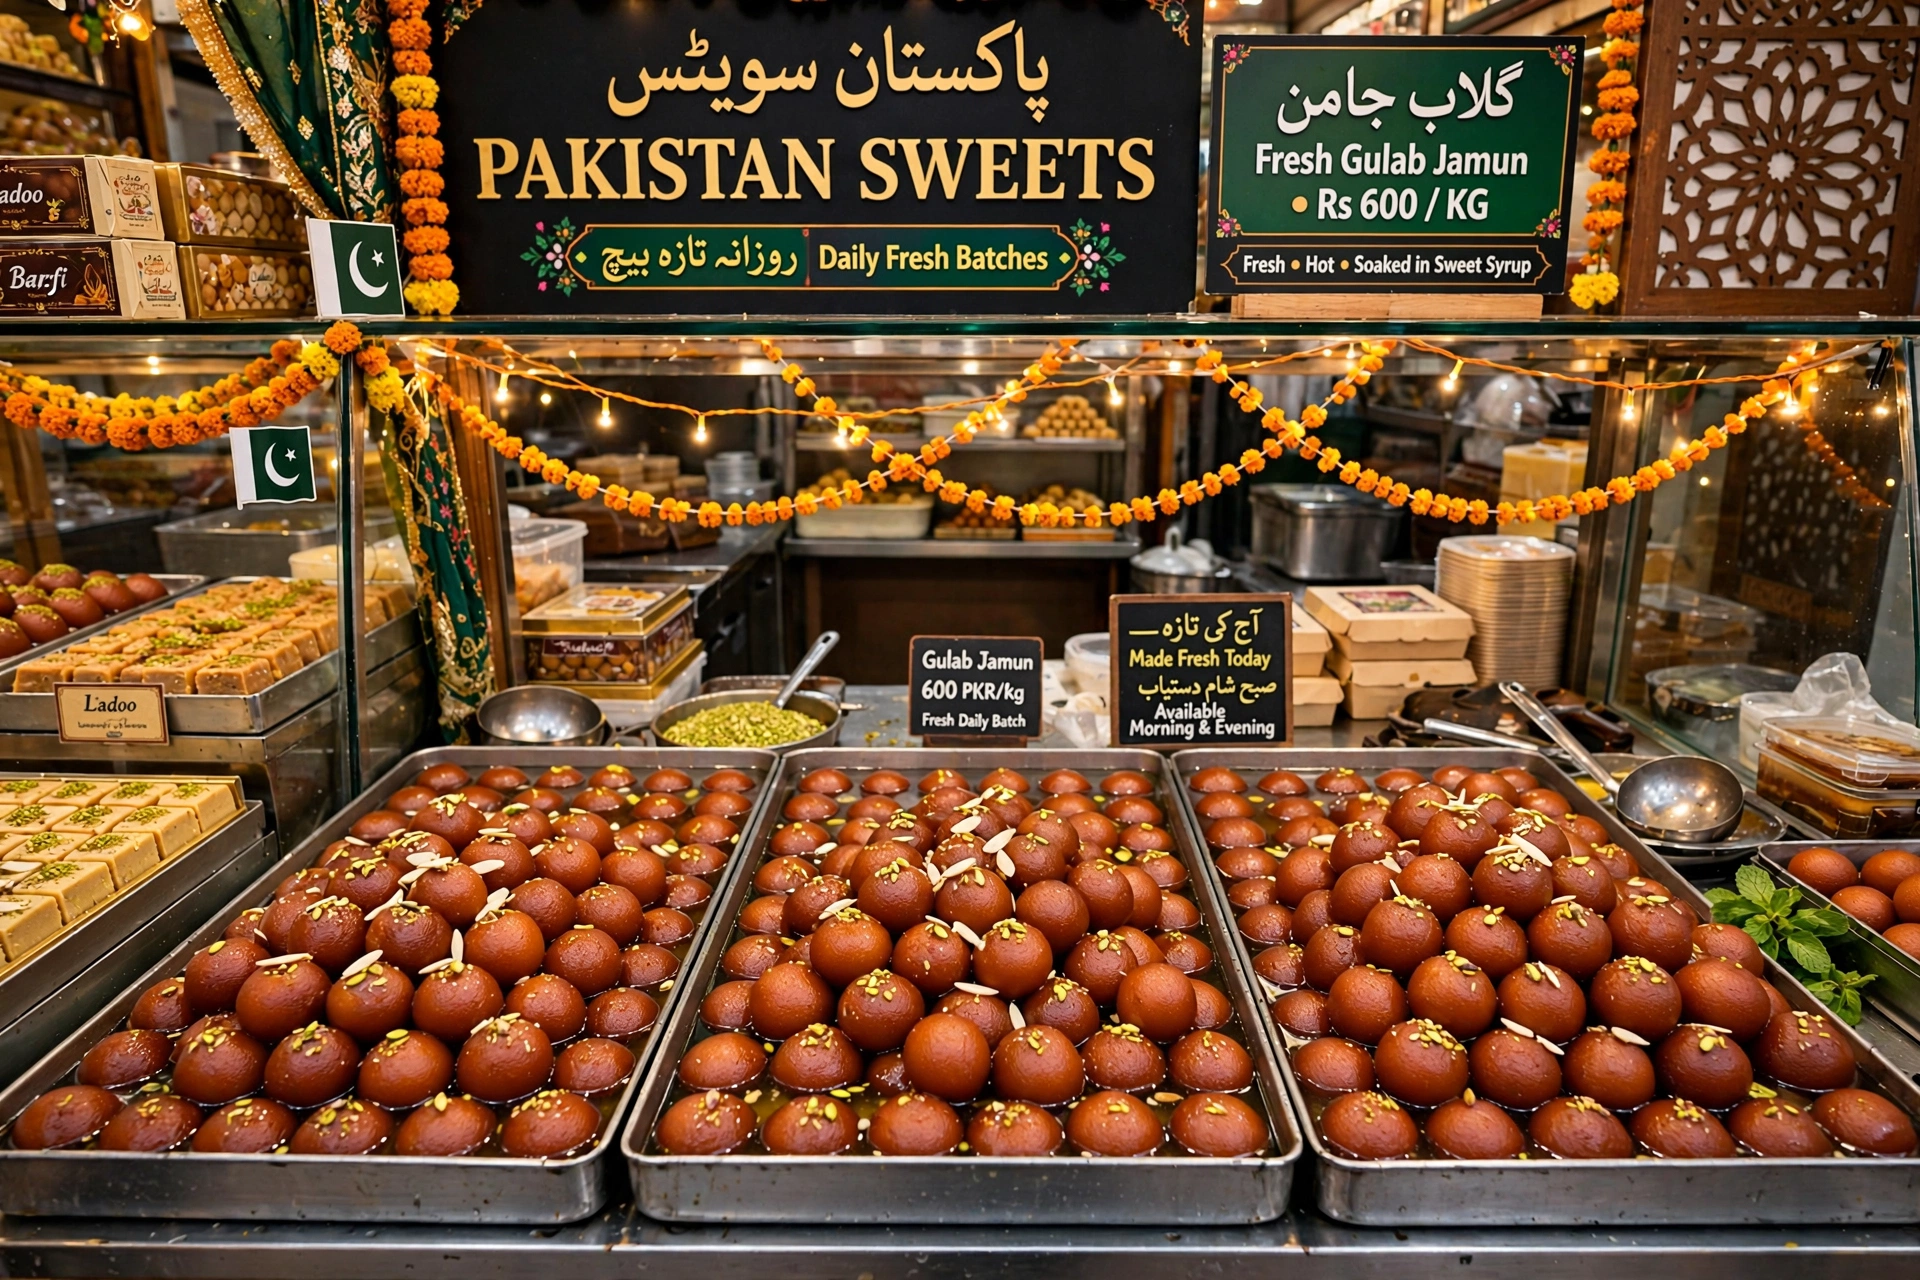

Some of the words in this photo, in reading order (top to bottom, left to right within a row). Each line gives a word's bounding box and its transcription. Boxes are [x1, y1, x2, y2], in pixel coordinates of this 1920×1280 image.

[607, 28, 818, 117] سویٹس
[835, 19, 1050, 123] پاکستان
[1277, 65, 1396, 134] جامن
[1409, 60, 1524, 134] گلاب
[473, 137, 836, 201] PAKISTAN
[860, 137, 1155, 201] SWEETS
[1255, 142, 1333, 175] Fresh
[1340, 142, 1427, 175] Gulab
[1432, 143, 1528, 176] Jamun
[0, 182, 44, 205] adoo
[1317, 187, 1353, 220] Rs
[1360, 187, 1418, 220] 600
[1424, 186, 1441, 222] /
[1446, 187, 1489, 221] KG
[601, 247, 650, 283] بیچ
[658, 234, 707, 276] تازہ
[714, 234, 798, 277] روزانہ
[818, 242, 880, 277] Daily
[886, 243, 949, 270] Fresh
[956, 243, 1049, 271] Batches
[1243, 254, 1286, 274] Fresh
[1305, 254, 1335, 274] Hot
[1353, 254, 1412, 274] Soaked
[1415, 254, 1430, 274] in
[1433, 254, 1483, 274] Sweet
[1485, 255, 1532, 279] Syrup
[1162, 612, 1200, 643] تازہ
[1204, 609, 1233, 643] کی
[1234, 607, 1264, 645] آج
[922, 648, 973, 670] Gulab
[976, 650, 1034, 671] Jamun
[1129, 648, 1174, 668] Made
[1177, 648, 1220, 667] Fresh
[1223, 648, 1272, 671] Today
[83, 694, 138, 713] Ladoo
[921, 679, 958, 700] 600
[962, 681, 1025, 706] PKR/kg
[1137, 675, 1202, 702] دستیاب
[1204, 674, 1236, 704] شام
[1239, 682, 1277, 704] صبح
[922, 712, 955, 727] Fresh
[958, 713, 990, 732] Daily
[991, 713, 1026, 728] Batch
[1153, 701, 1227, 720] Available
[1129, 718, 1195, 741] Morning
[1198, 719, 1211, 735] &
[1215, 718, 1275, 740] Evening
